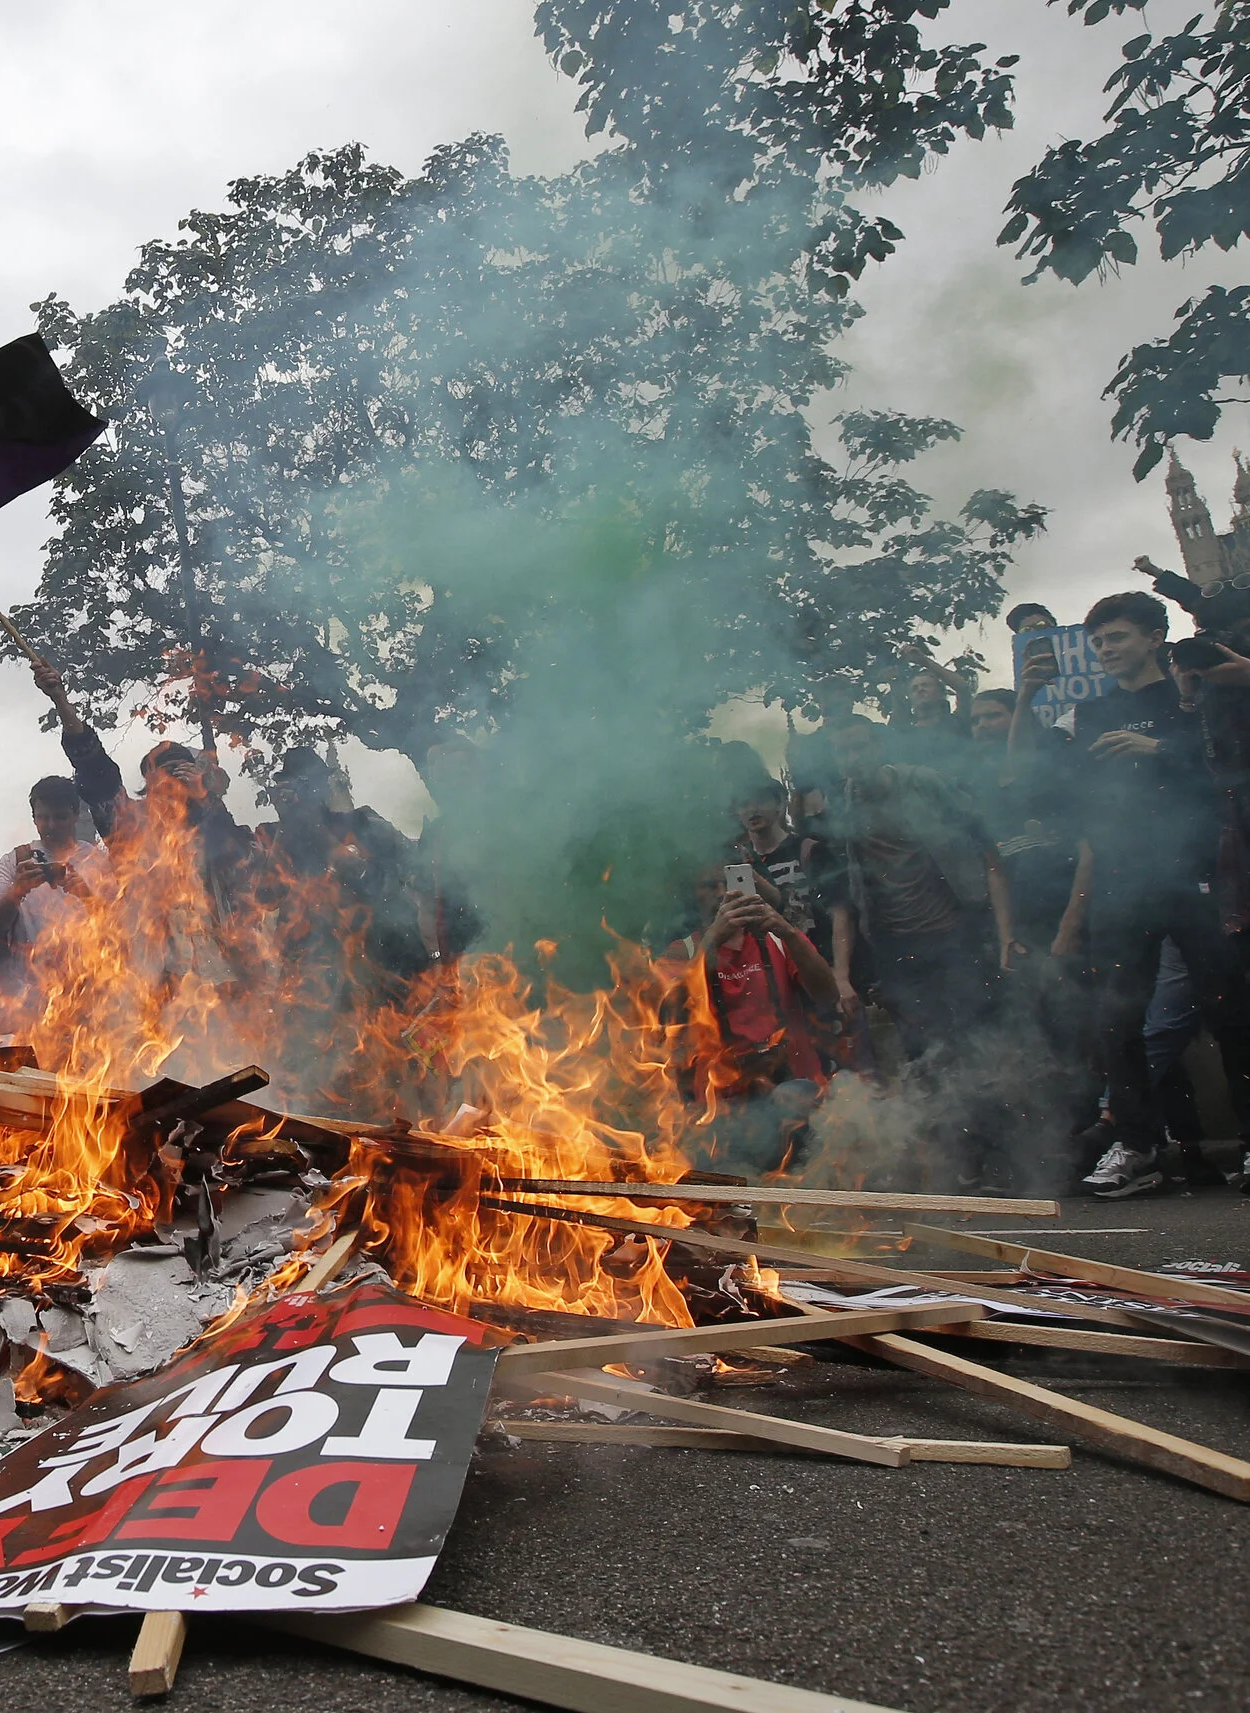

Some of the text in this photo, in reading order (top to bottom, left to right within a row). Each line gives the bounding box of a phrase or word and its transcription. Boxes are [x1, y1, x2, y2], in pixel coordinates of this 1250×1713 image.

[1046, 673, 1106, 702] NOT
[37, 1332, 468, 1470] RULE
[63, 1554, 347, 1597] Socialist
